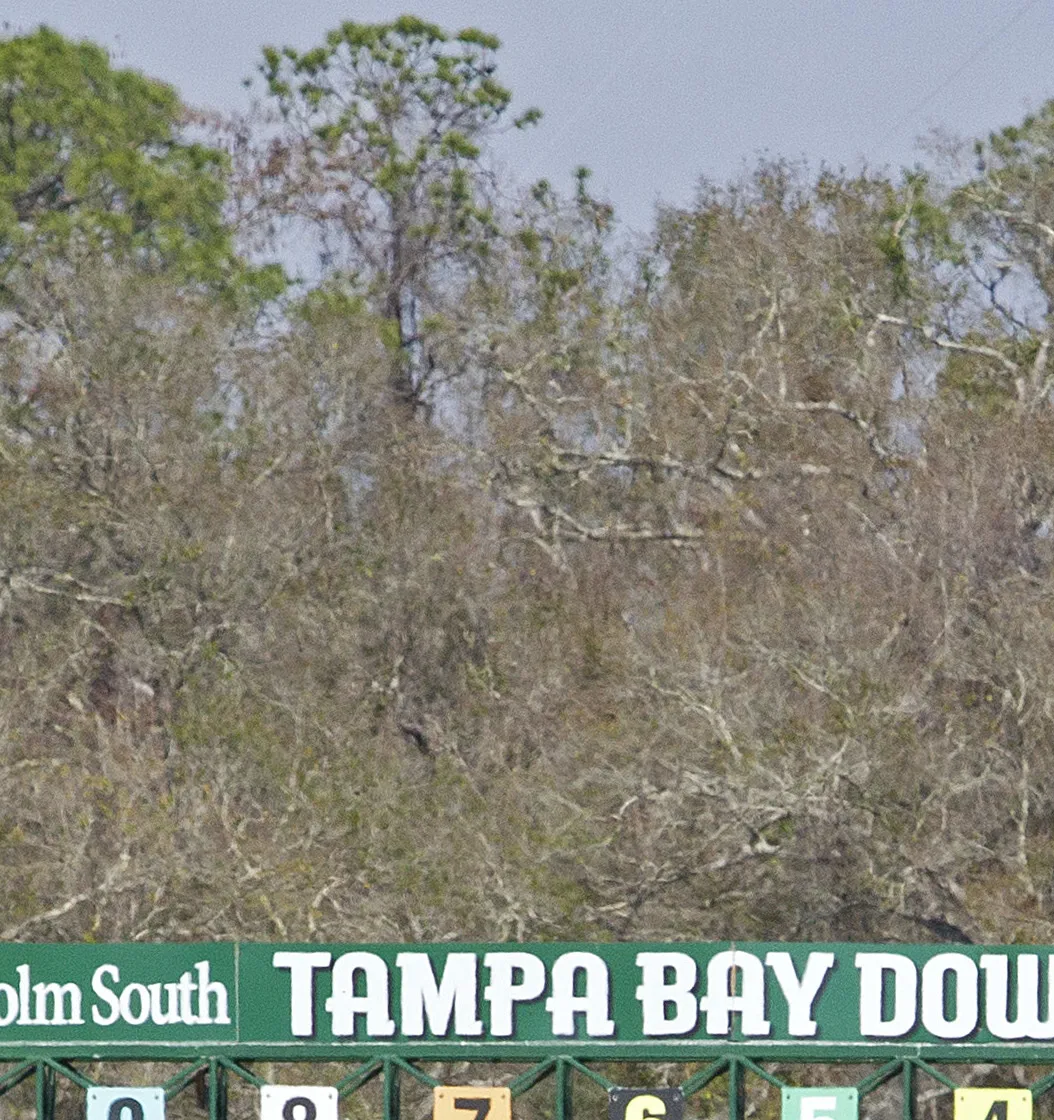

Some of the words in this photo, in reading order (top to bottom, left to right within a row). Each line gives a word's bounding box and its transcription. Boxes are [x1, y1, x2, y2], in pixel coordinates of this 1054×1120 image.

[91, 961, 231, 1026] South
[272, 951, 616, 1037] TAMPA
[635, 950, 835, 1037] BAY
